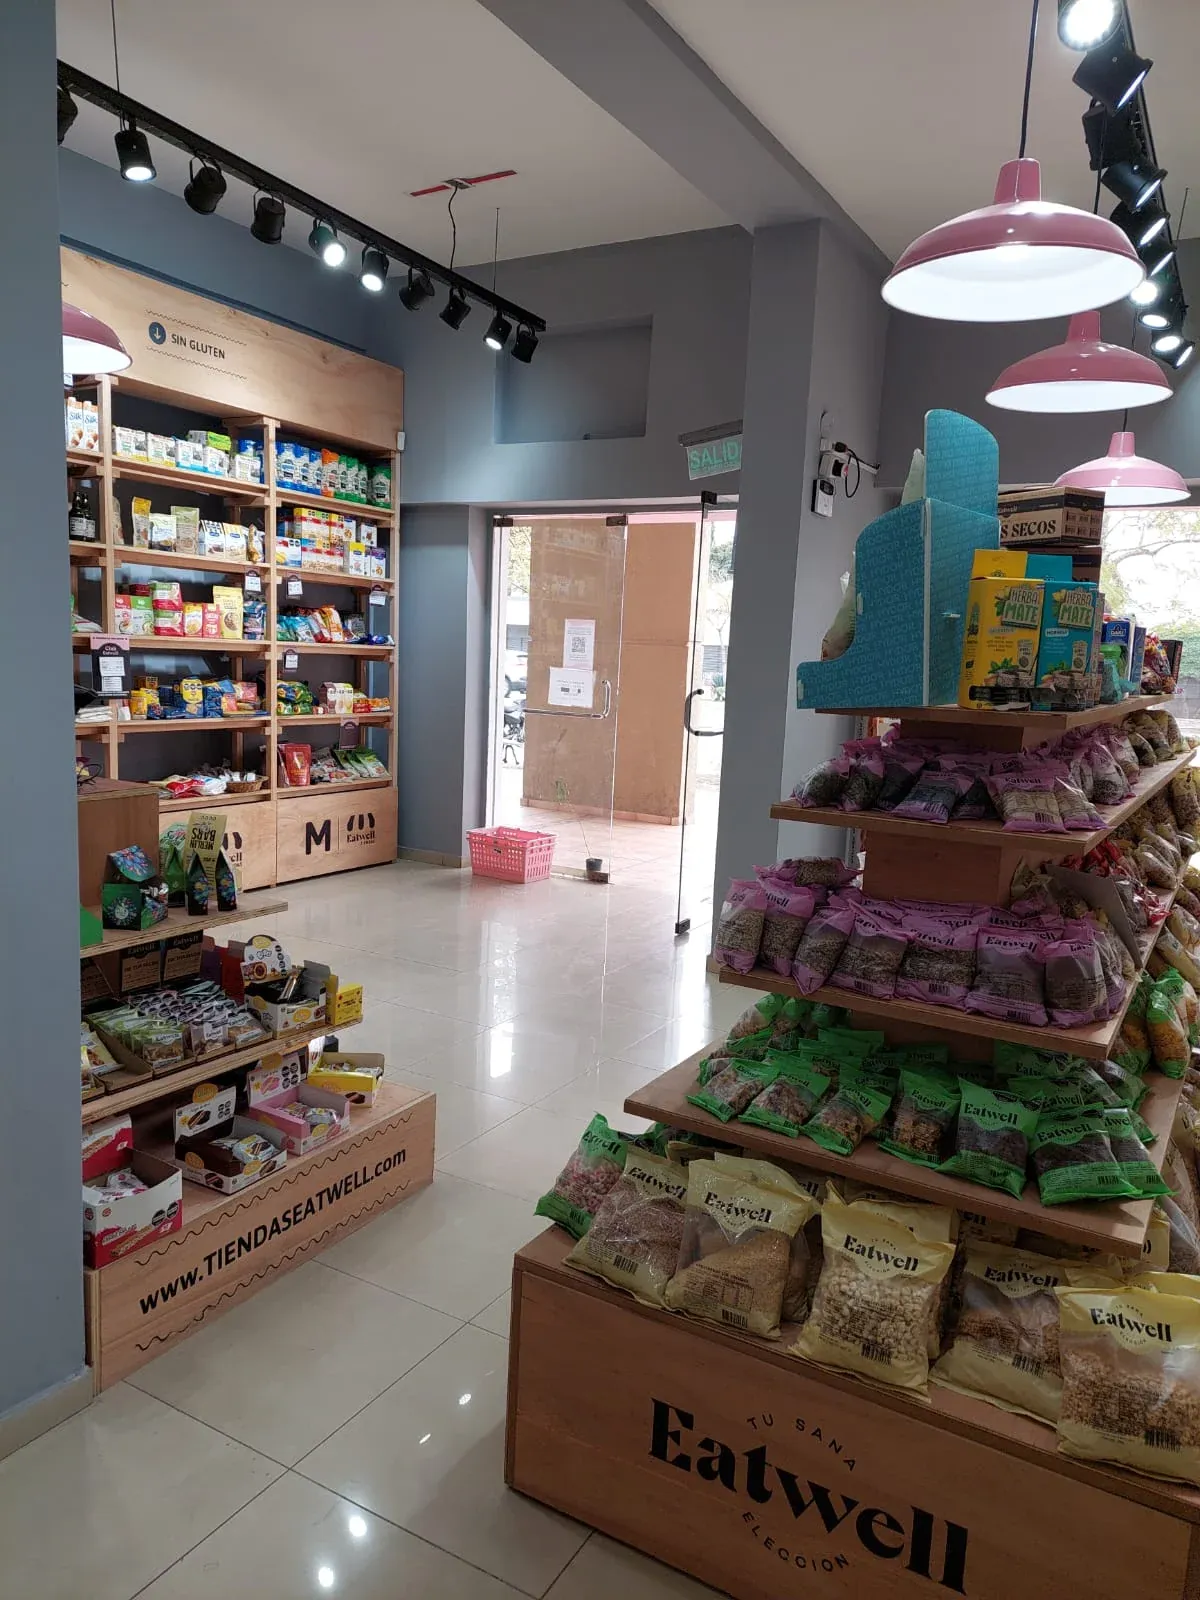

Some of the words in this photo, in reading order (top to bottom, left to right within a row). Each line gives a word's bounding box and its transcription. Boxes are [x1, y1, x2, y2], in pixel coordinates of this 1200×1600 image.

[171, 333, 187, 347] SIN
[189, 339, 225, 359] GLUTEN
[1010, 519, 1057, 538] SECOS
[1010, 588, 1039, 604] HERBA
[1066, 591, 1092, 606] HERBA
[1003, 602, 1039, 622] MATE
[1060, 605, 1092, 624] MATE
[189, 839, 215, 851] MERLIN
[191, 827, 217, 841] BARS
[305, 819, 332, 856] M
[985, 936, 1037, 953] Eatwell
[911, 1088, 947, 1109] Eatwell
[963, 1102, 1019, 1125] Eatwell
[1036, 1123, 1093, 1142] Eatwell
[627, 1166, 688, 1200] Eatwell
[703, 1191, 773, 1224] Eatwell
[138, 1148, 407, 1316] www.TIENDASEATWELL.com
[843, 1233, 919, 1272] Eatwell
[983, 1265, 1060, 1288] Eatwell
[1089, 1307, 1173, 1343] Eatwell
[747, 1413, 775, 1431] TU
[795, 1417, 857, 1472] SANA
[648, 1397, 969, 1597] Eatwell
[741, 1511, 851, 1573] ELECCION
